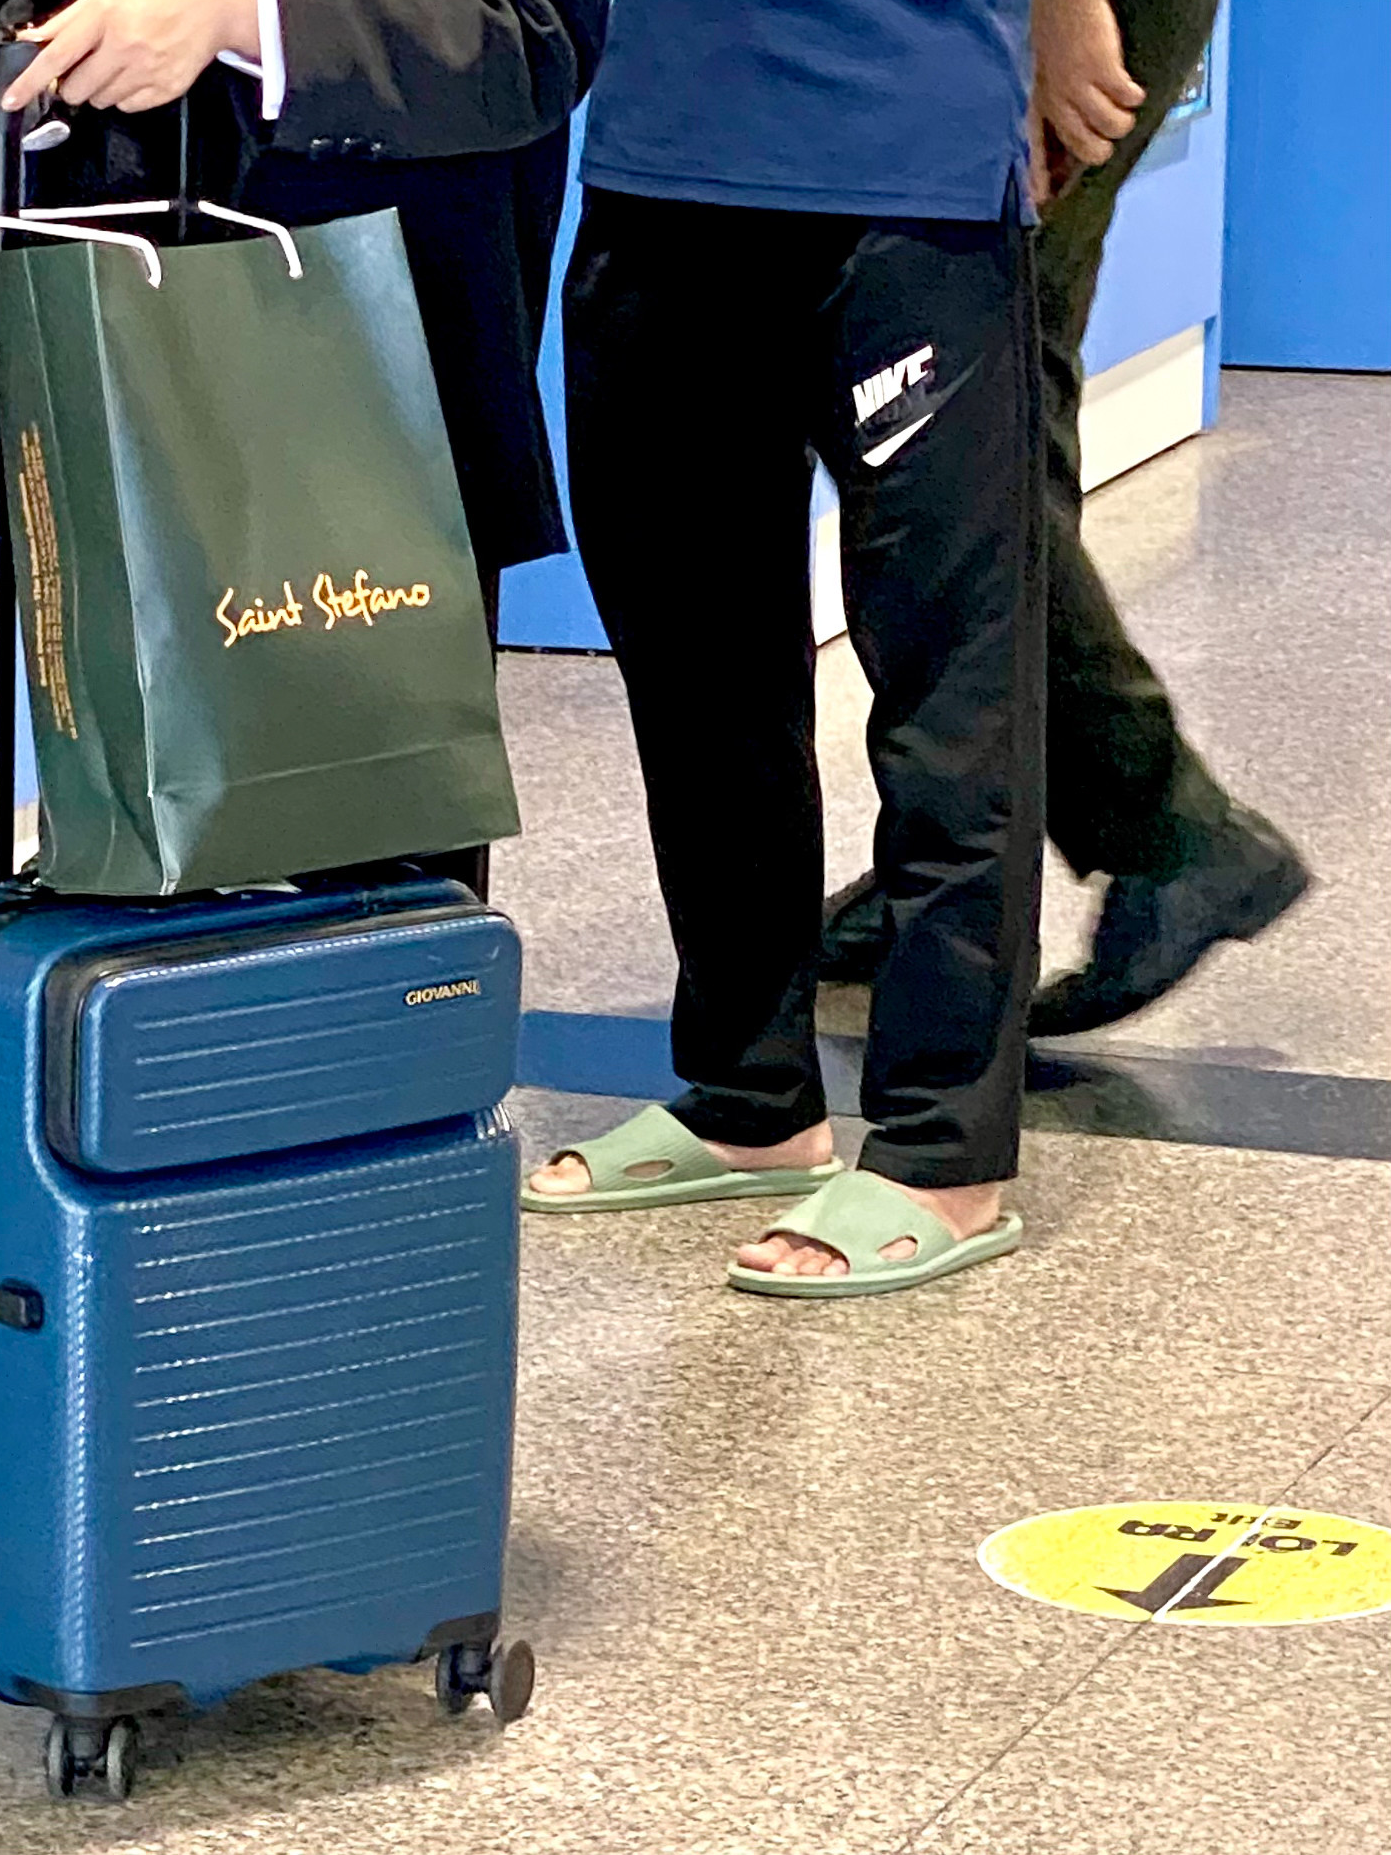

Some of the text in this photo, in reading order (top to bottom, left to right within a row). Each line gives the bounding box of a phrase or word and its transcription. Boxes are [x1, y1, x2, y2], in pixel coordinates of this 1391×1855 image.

[216, 569, 431, 648] Saint Stefano
[405, 980, 480, 1006] GIOVANNI
[1117, 1519, 1217, 1543] RA
